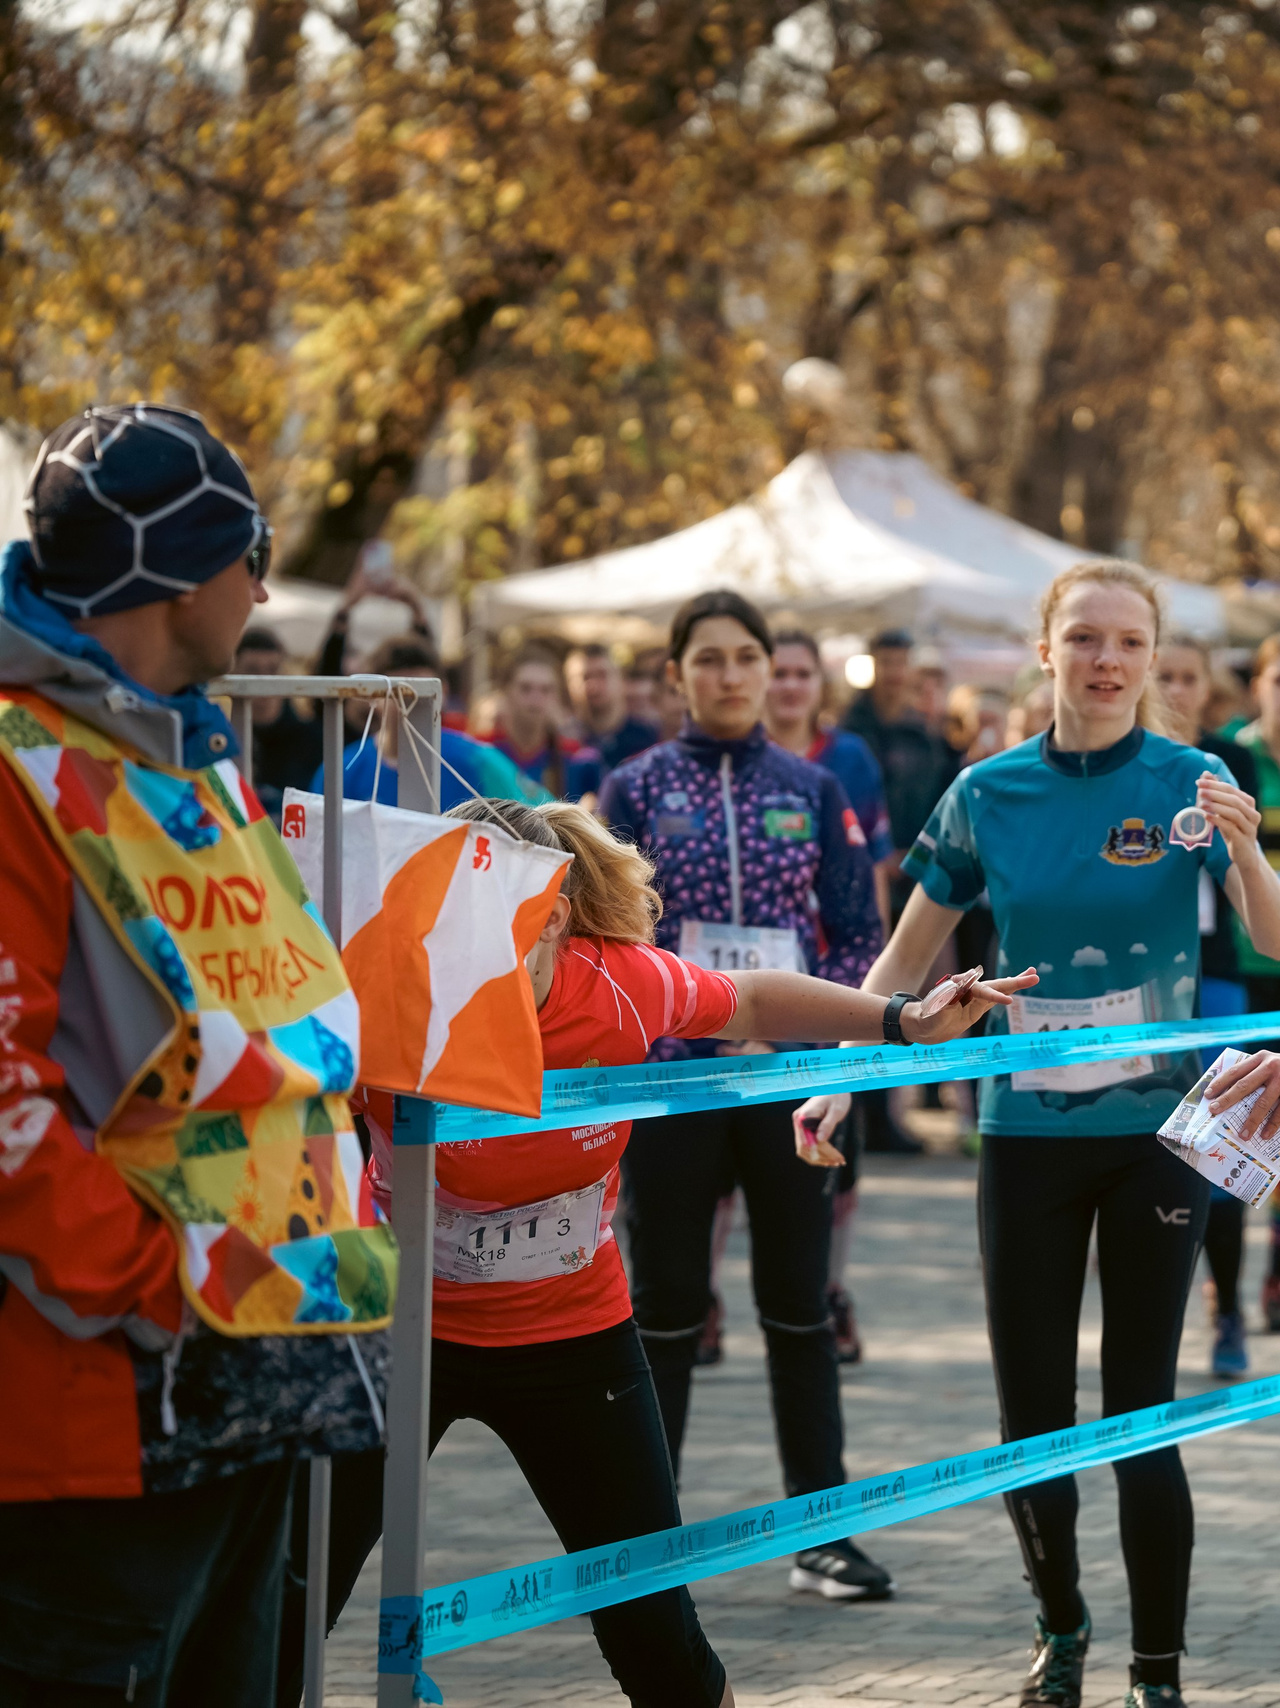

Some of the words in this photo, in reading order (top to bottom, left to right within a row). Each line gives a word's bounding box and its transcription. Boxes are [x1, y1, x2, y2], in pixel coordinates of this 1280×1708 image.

[582, 1130, 617, 1151] ОБЛАСТЬ
[1155, 1206, 1191, 1224] VC
[469, 1216, 539, 1249] 111
[557, 1218, 571, 1236] 3
